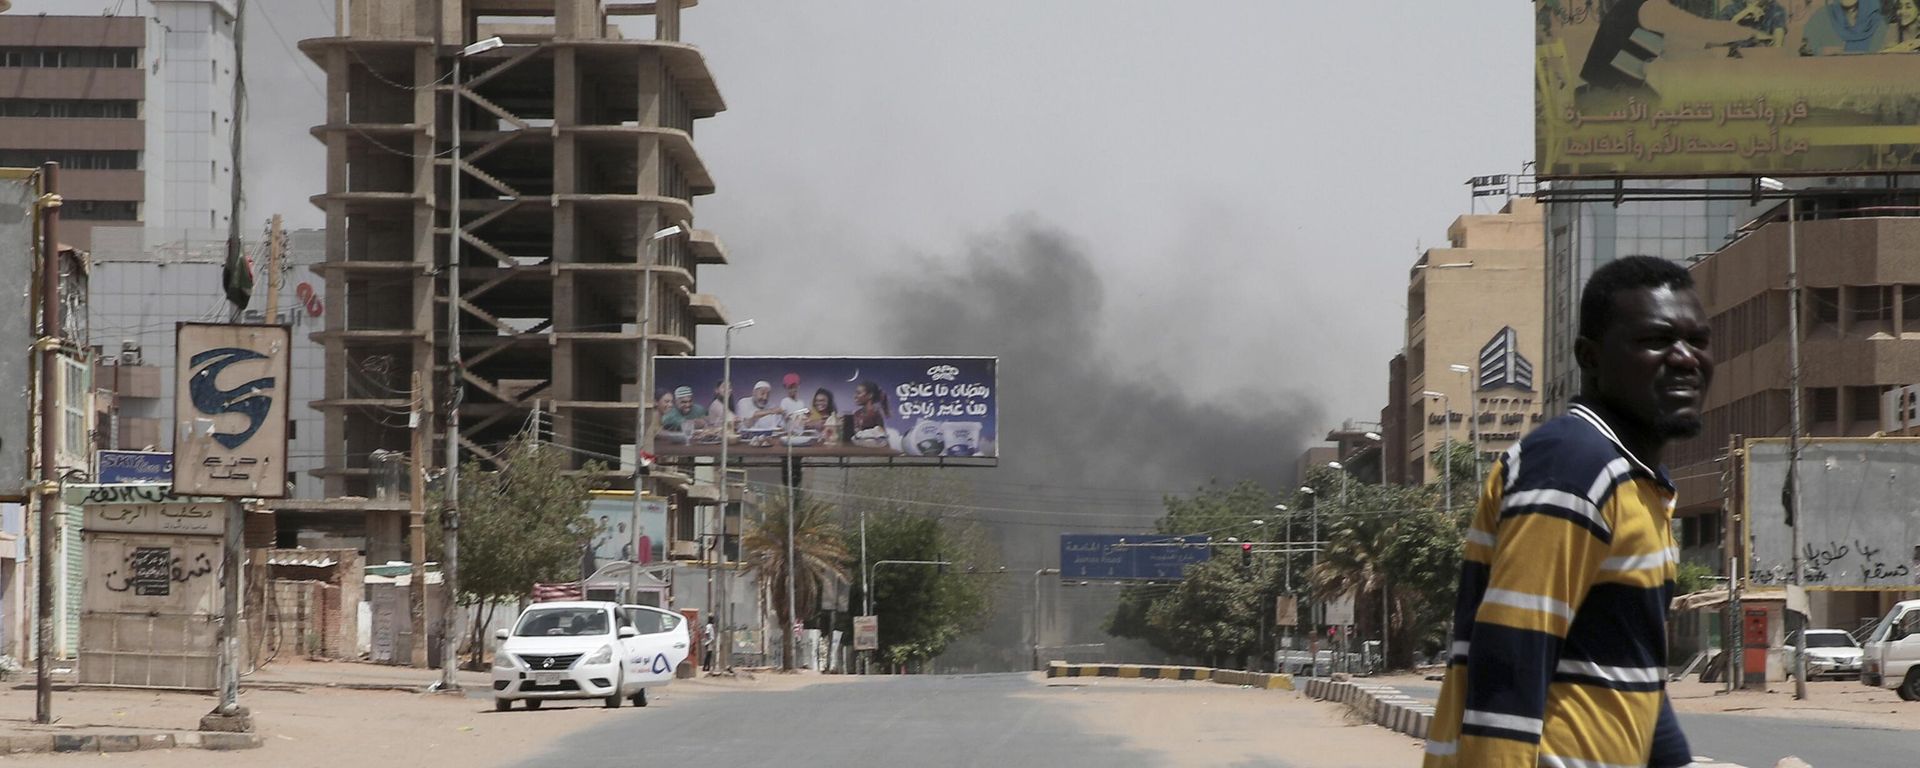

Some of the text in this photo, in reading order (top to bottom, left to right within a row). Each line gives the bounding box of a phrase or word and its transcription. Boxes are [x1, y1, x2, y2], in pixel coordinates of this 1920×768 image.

[1651, 102, 1713, 128] تنظيم
[1779, 100, 1808, 125] قرر
[1647, 128, 1680, 160] الأم
[1687, 137, 1736, 154] صحة
[1740, 127, 1778, 157] أجل
[1780, 137, 1808, 156] من
[934, 383, 949, 397] ما
[950, 383, 990, 399] رمضان
[936, 400, 965, 417] غير
